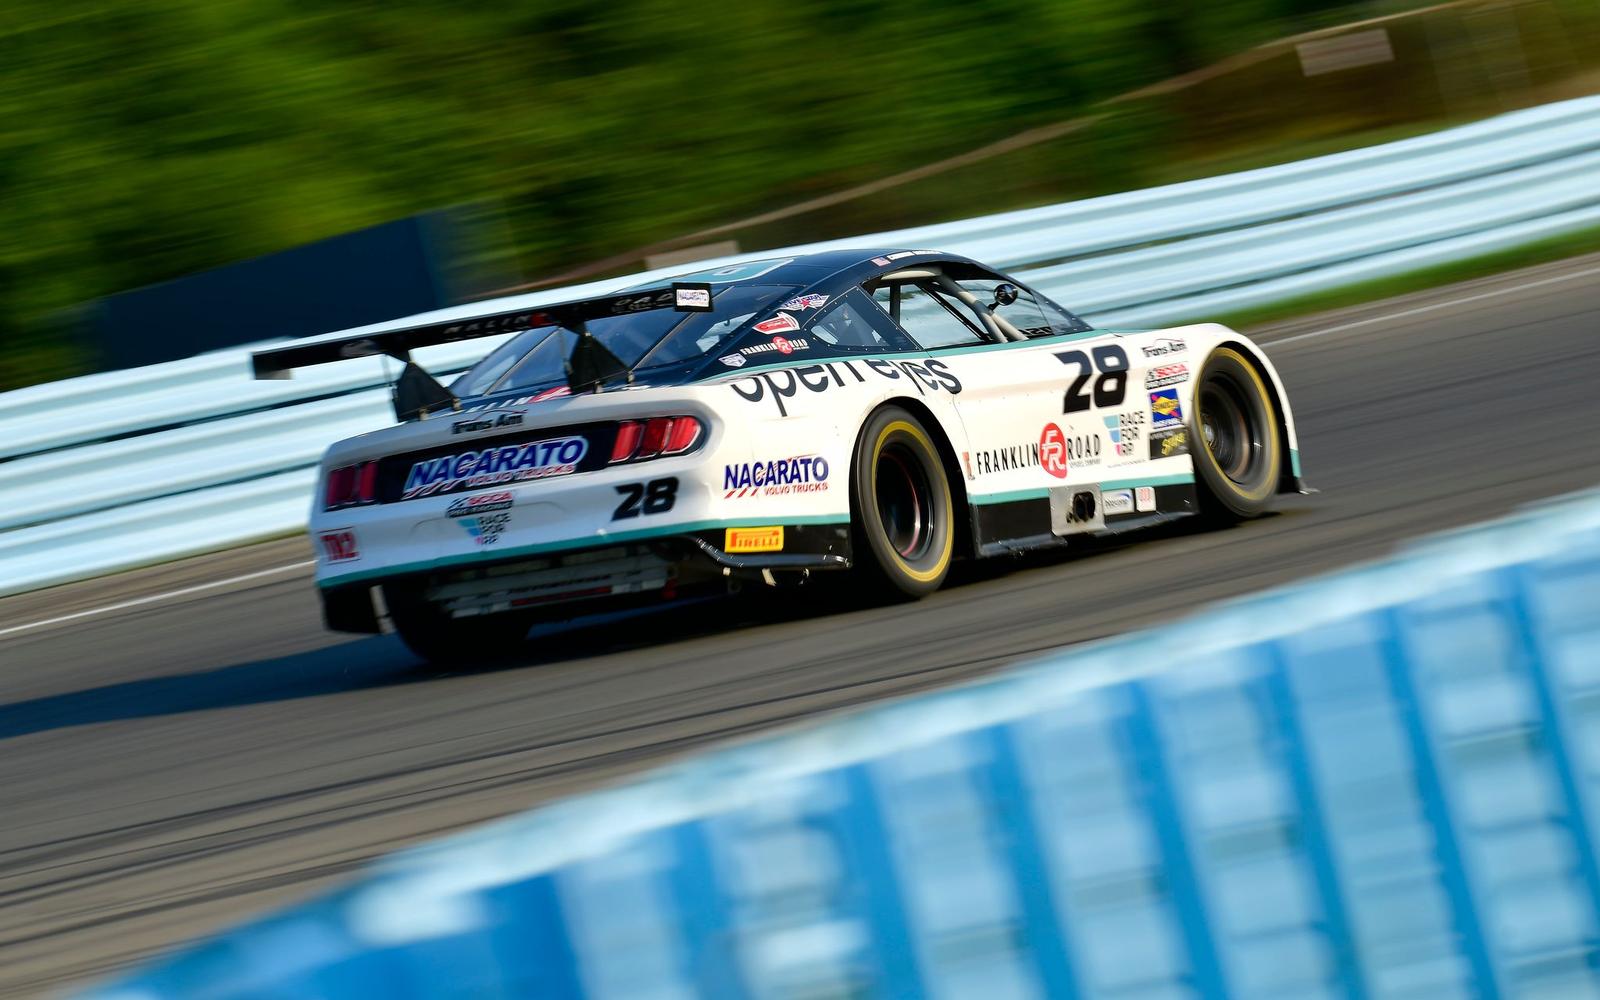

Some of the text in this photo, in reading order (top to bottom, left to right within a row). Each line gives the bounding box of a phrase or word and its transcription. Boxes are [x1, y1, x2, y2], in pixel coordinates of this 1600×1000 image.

[740, 343, 777, 355] FRANKLIN
[791, 339, 808, 348] ROAD
[731, 359, 962, 417] open eyes
[1053, 344, 1129, 414] 28
[409, 438, 585, 488] NACARATO
[515, 464, 576, 480] TRUCKS
[724, 456, 829, 490] NACARATO
[976, 442, 1040, 475] FRANKLIN
[1067, 434, 1101, 460] ROAD
[610, 477, 679, 521] 28
[764, 481, 829, 496] VOLVO TRUCKS
[730, 530, 779, 548] PIRELLI
